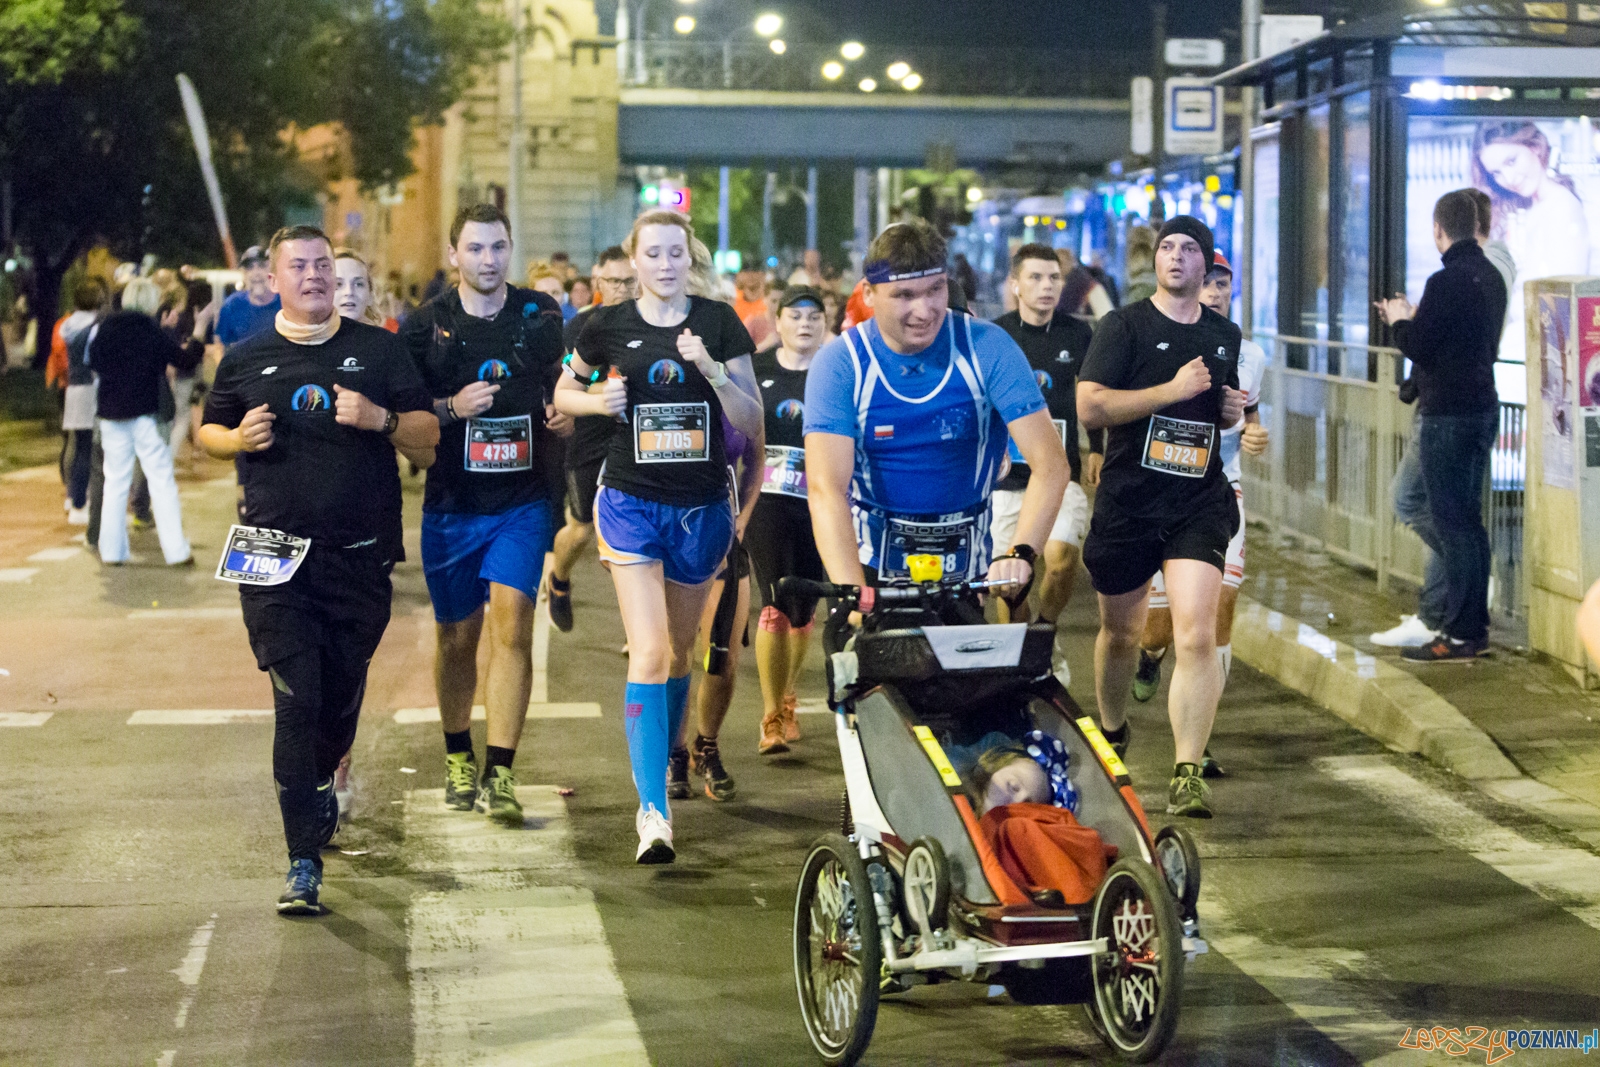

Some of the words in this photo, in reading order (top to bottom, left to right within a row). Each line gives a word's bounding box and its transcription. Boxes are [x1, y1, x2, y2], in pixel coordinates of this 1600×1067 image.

[654, 432, 692, 449] 7705
[483, 444, 517, 460] 4738
[1163, 445, 1198, 464] 9724
[242, 555, 281, 574] 7190
